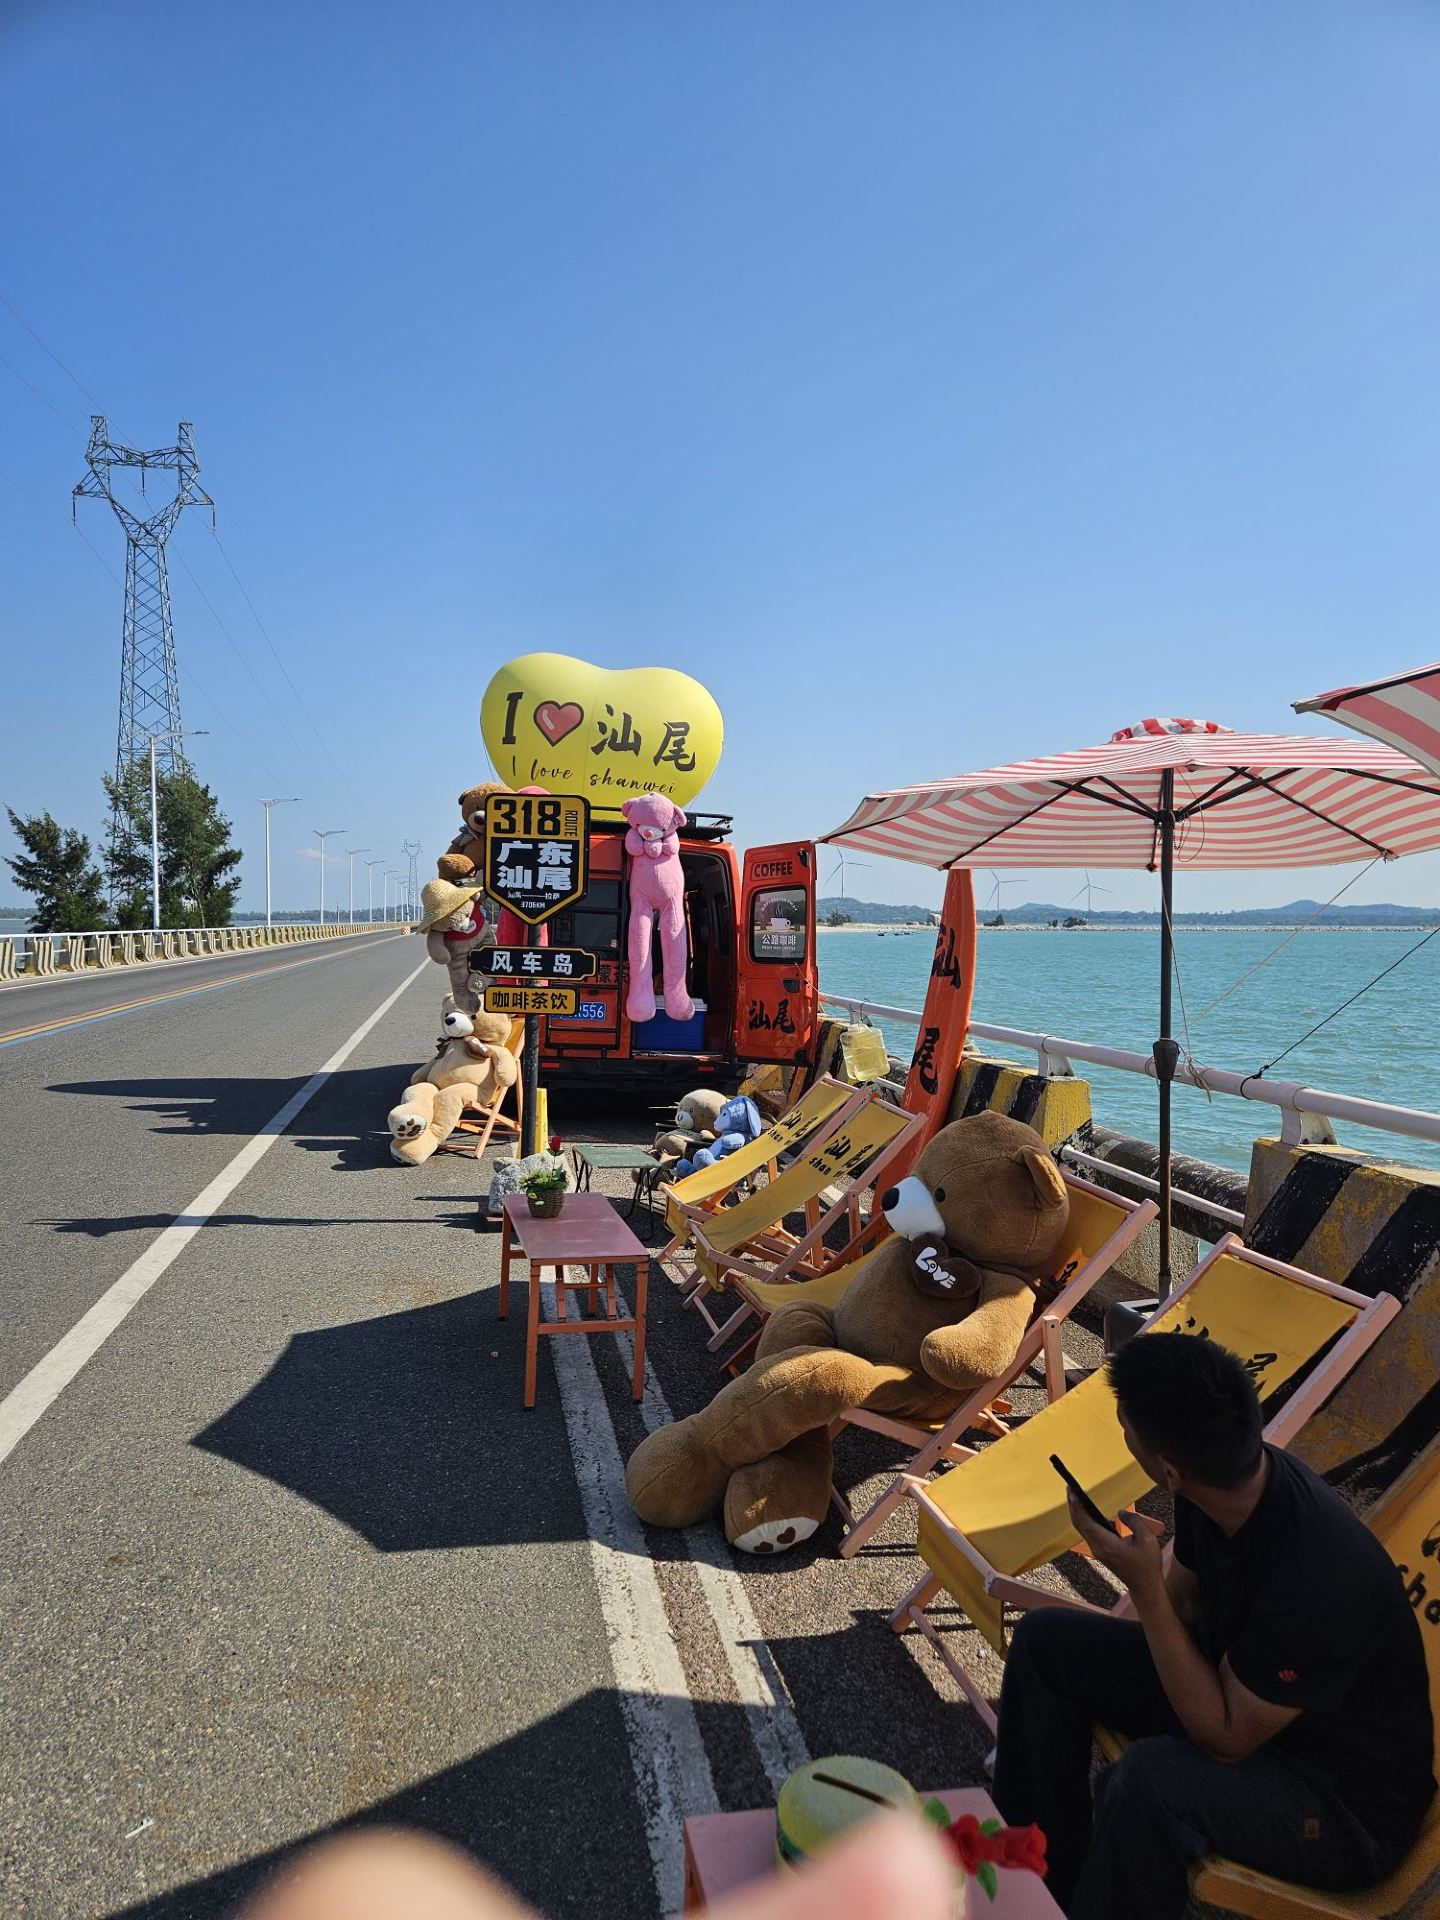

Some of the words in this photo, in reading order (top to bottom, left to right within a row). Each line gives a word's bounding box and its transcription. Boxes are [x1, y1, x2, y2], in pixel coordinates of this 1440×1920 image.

[502, 692, 523, 744] I
[591, 704, 696, 771] 汕尾
[530, 758, 574, 780] love
[590, 768, 677, 794] shanwei
[494, 799, 562, 835] 318
[565, 810, 578, 837] ROUTE
[497, 840, 573, 865] 广东
[497, 865, 573, 891] 汕尾
[754, 861, 793, 877] COFFEE
[491, 951, 573, 975] 风车岛
[492, 991, 568, 1010] 咖啡茶饮
[749, 998, 795, 1034] 汕尾
